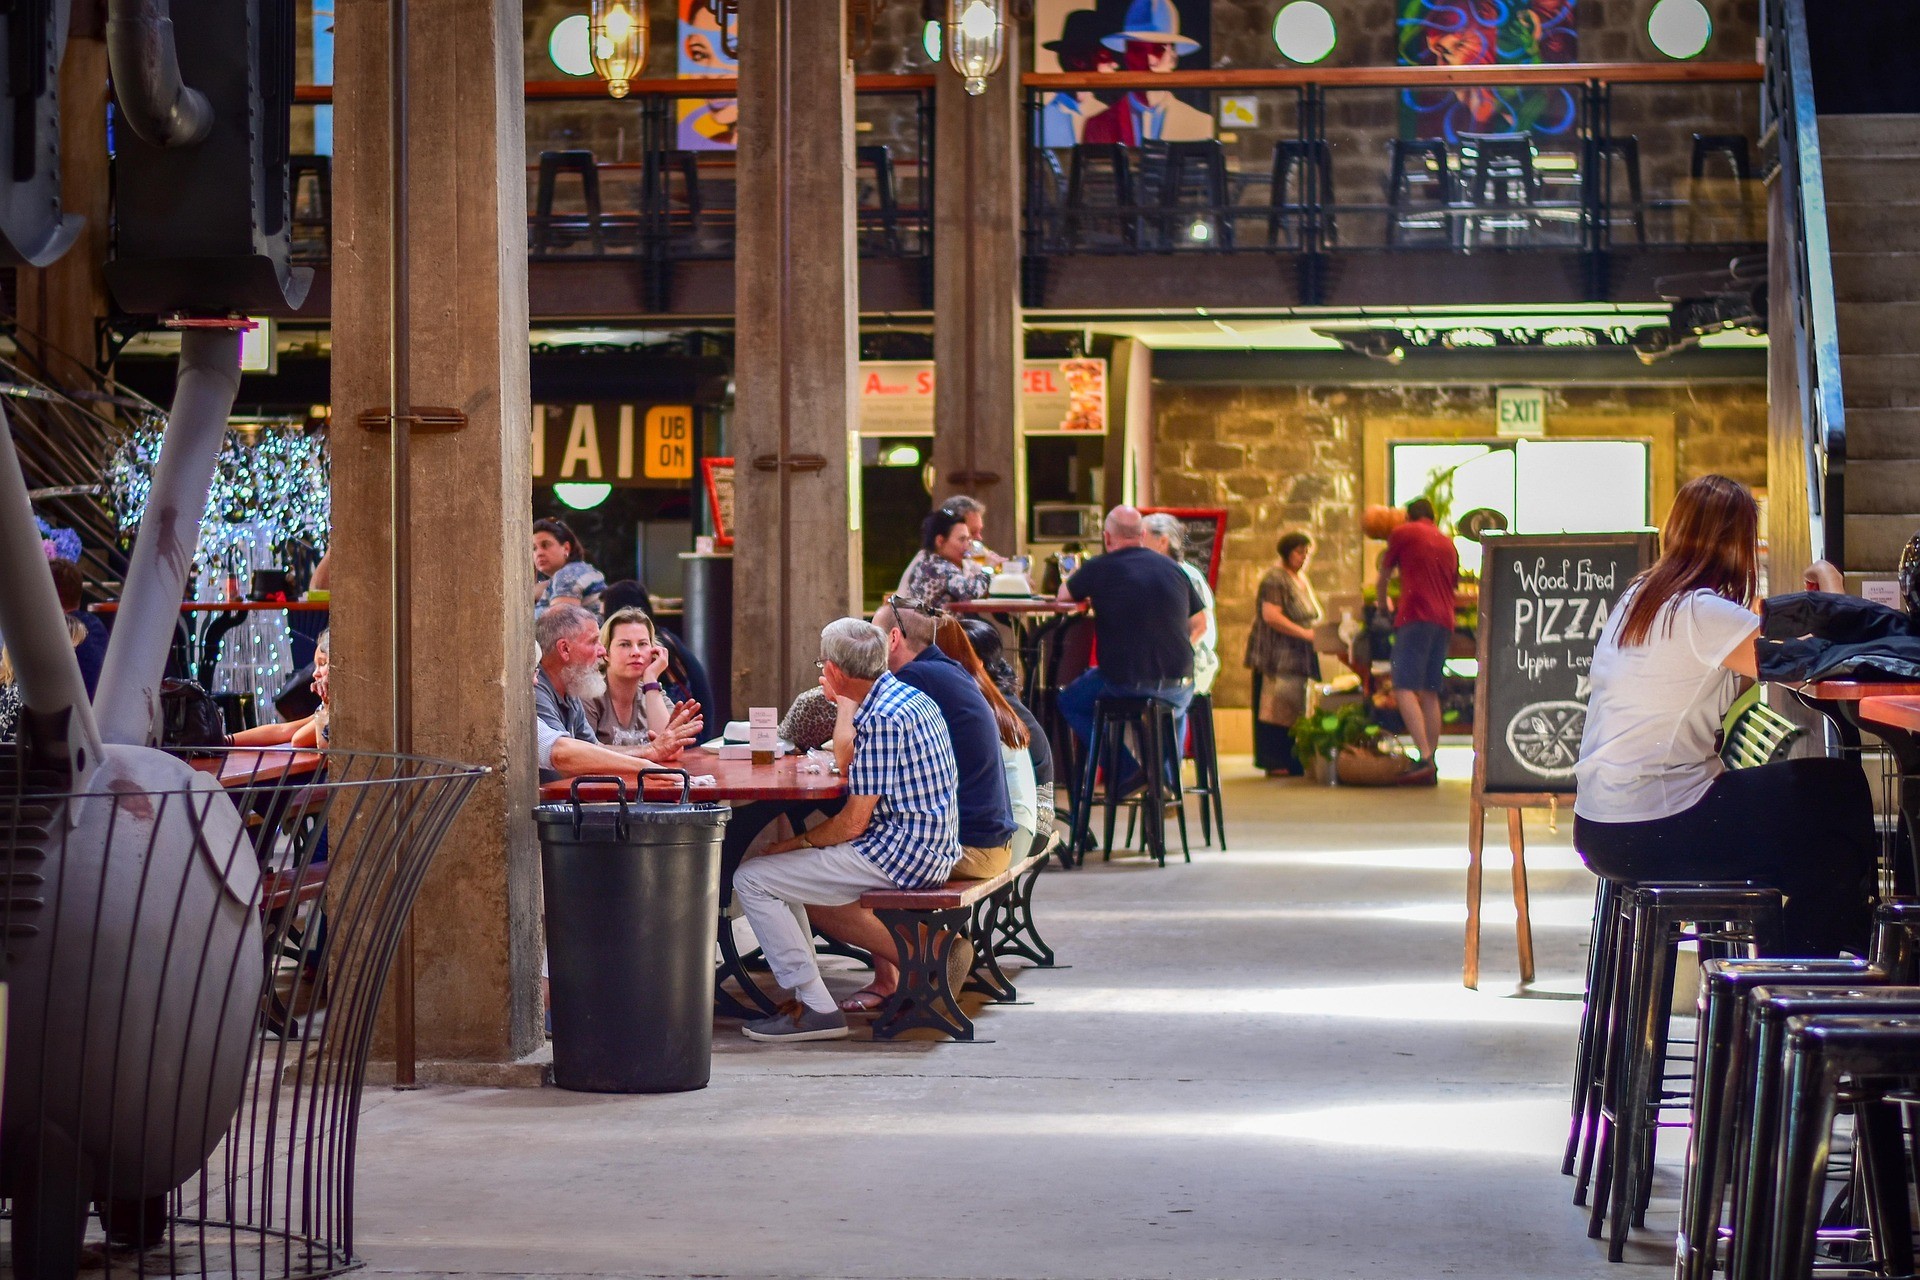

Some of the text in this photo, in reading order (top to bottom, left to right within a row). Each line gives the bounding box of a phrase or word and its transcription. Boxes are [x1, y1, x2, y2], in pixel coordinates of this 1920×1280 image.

[1501, 399, 1540, 423] EXIT
[660, 416, 685, 440] UB
[659, 444, 685, 467] ON
[1513, 556, 1617, 597] Wood Fired
[1514, 598, 1609, 645] PIZZA
